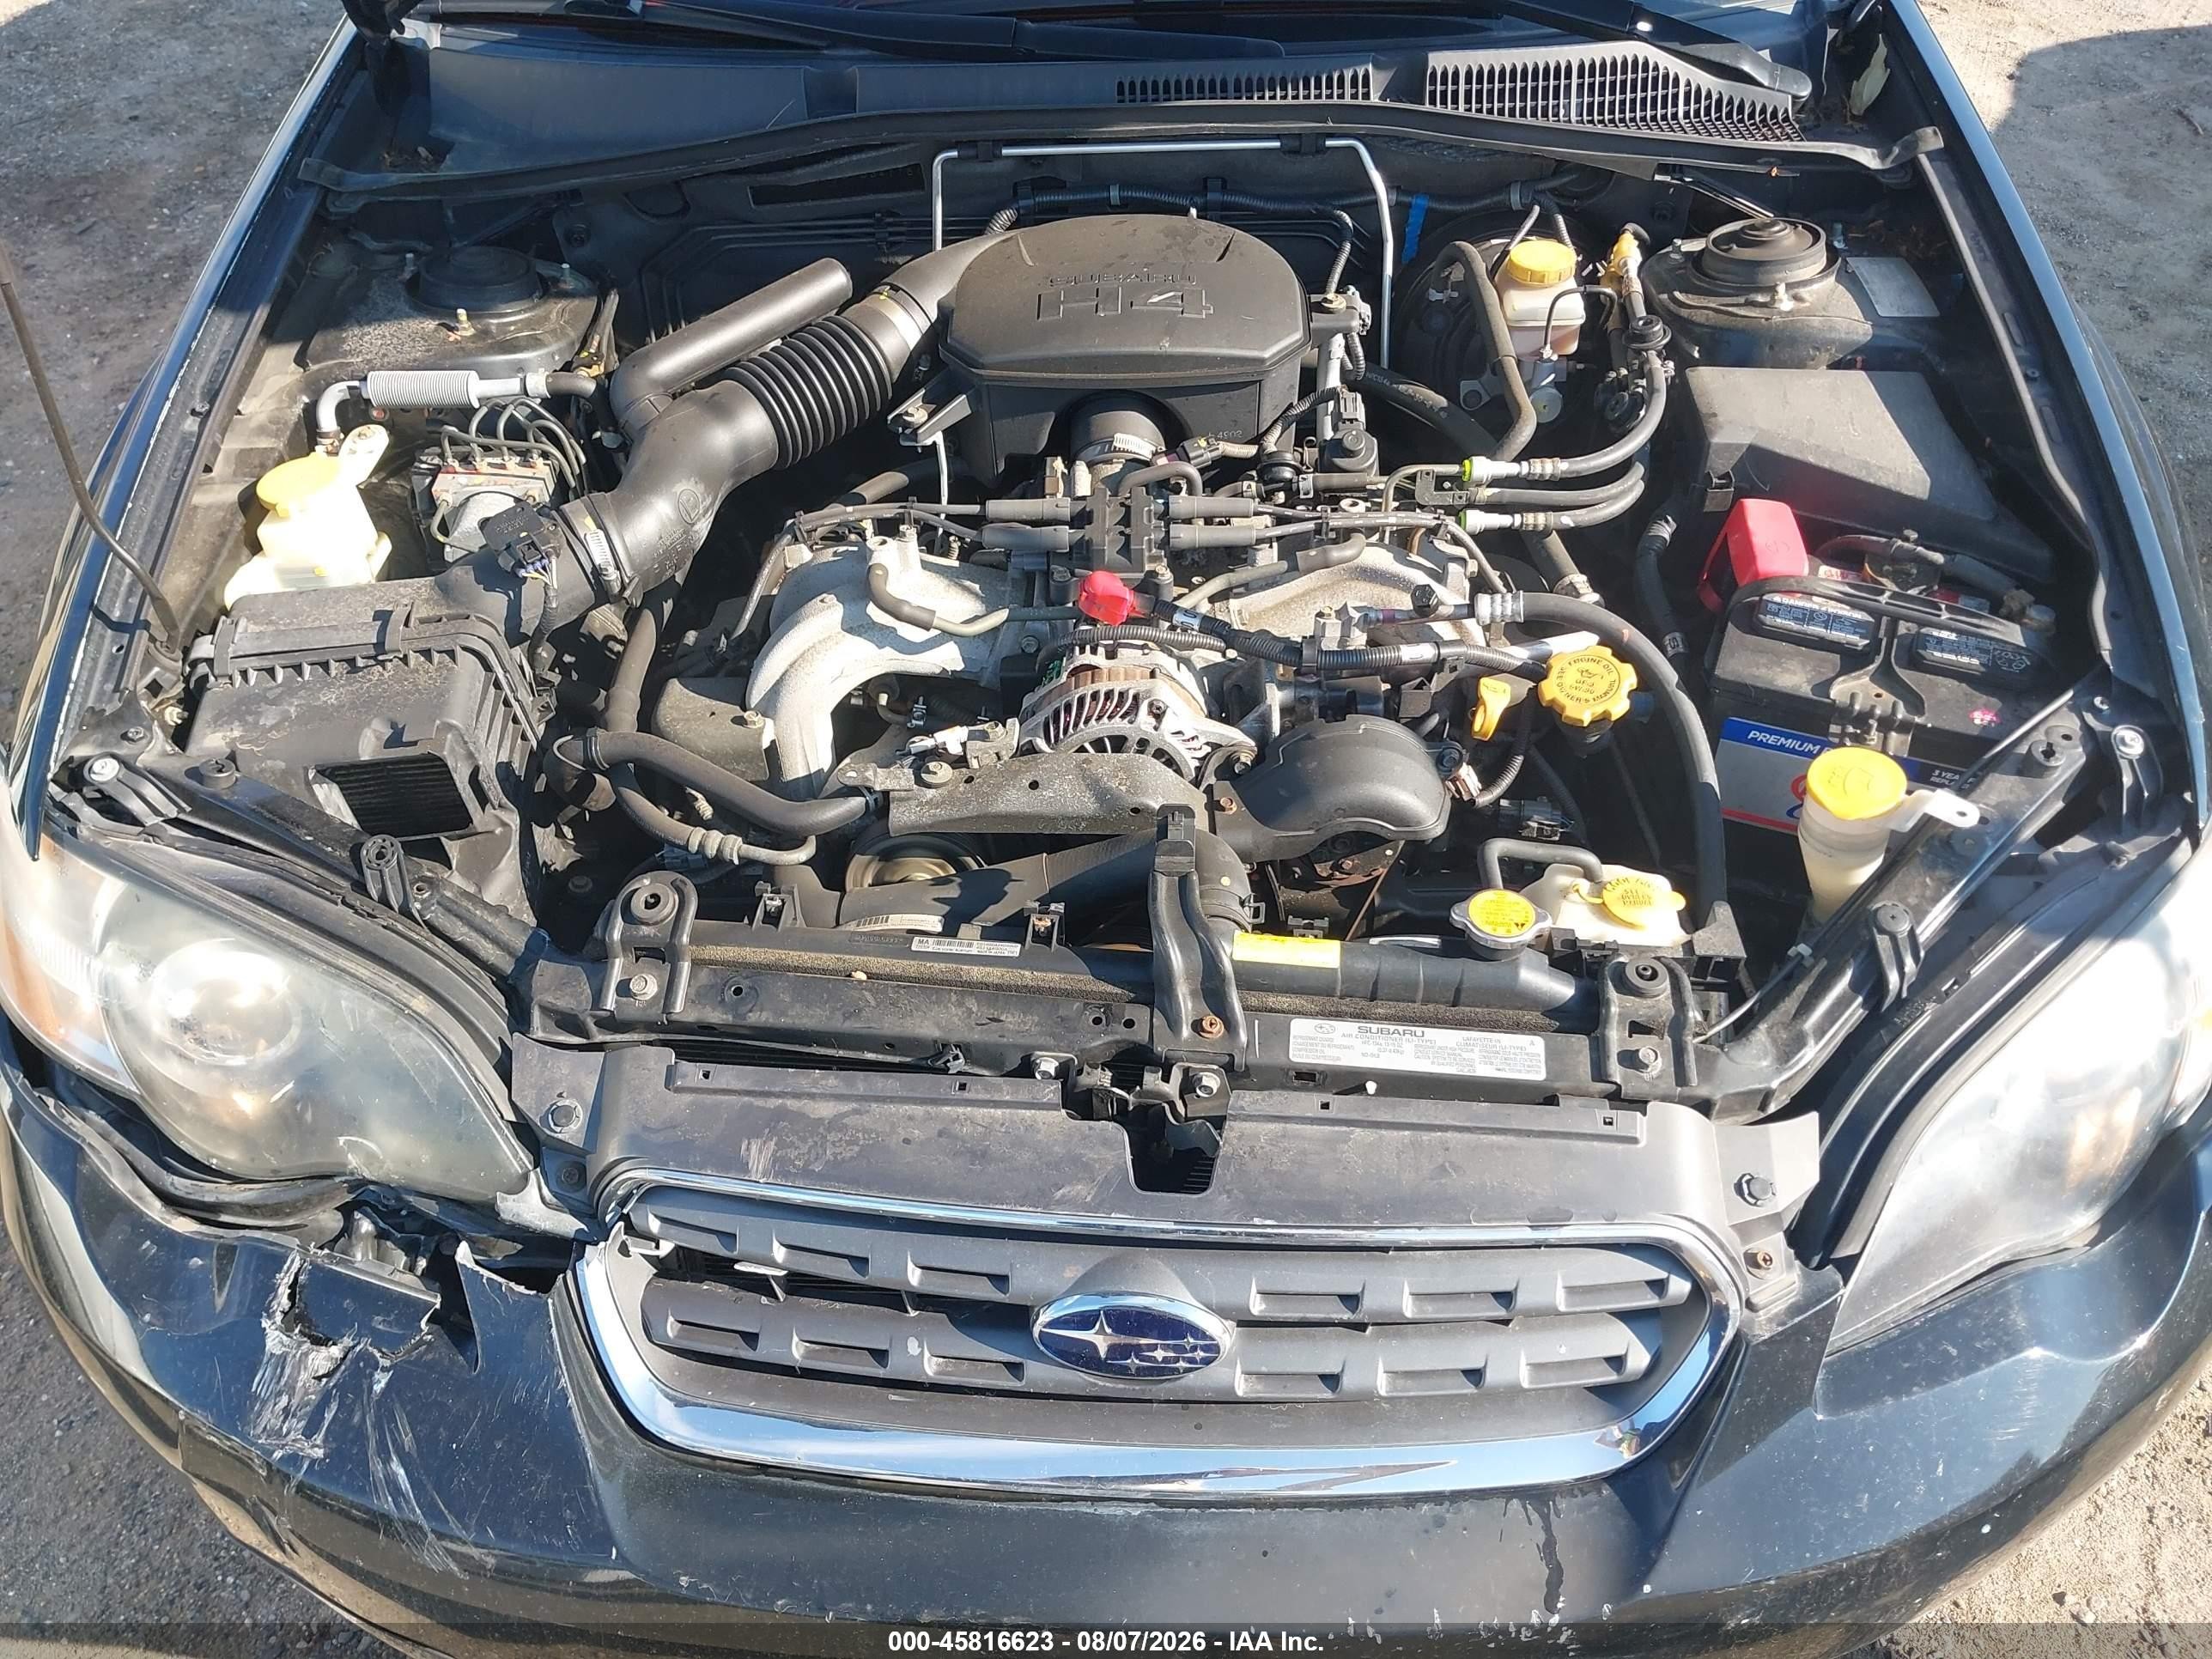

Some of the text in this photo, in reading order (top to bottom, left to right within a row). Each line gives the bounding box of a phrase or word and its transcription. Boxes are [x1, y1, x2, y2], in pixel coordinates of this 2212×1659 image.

[1049, 273, 1197, 287] SUBARU
[1036, 285, 1213, 320] H4
[1747, 730, 1821, 754] PREMIUM
[1354, 1034, 1403, 1043] CONDITIONER
[1357, 1025, 1425, 1038] SUBARU
